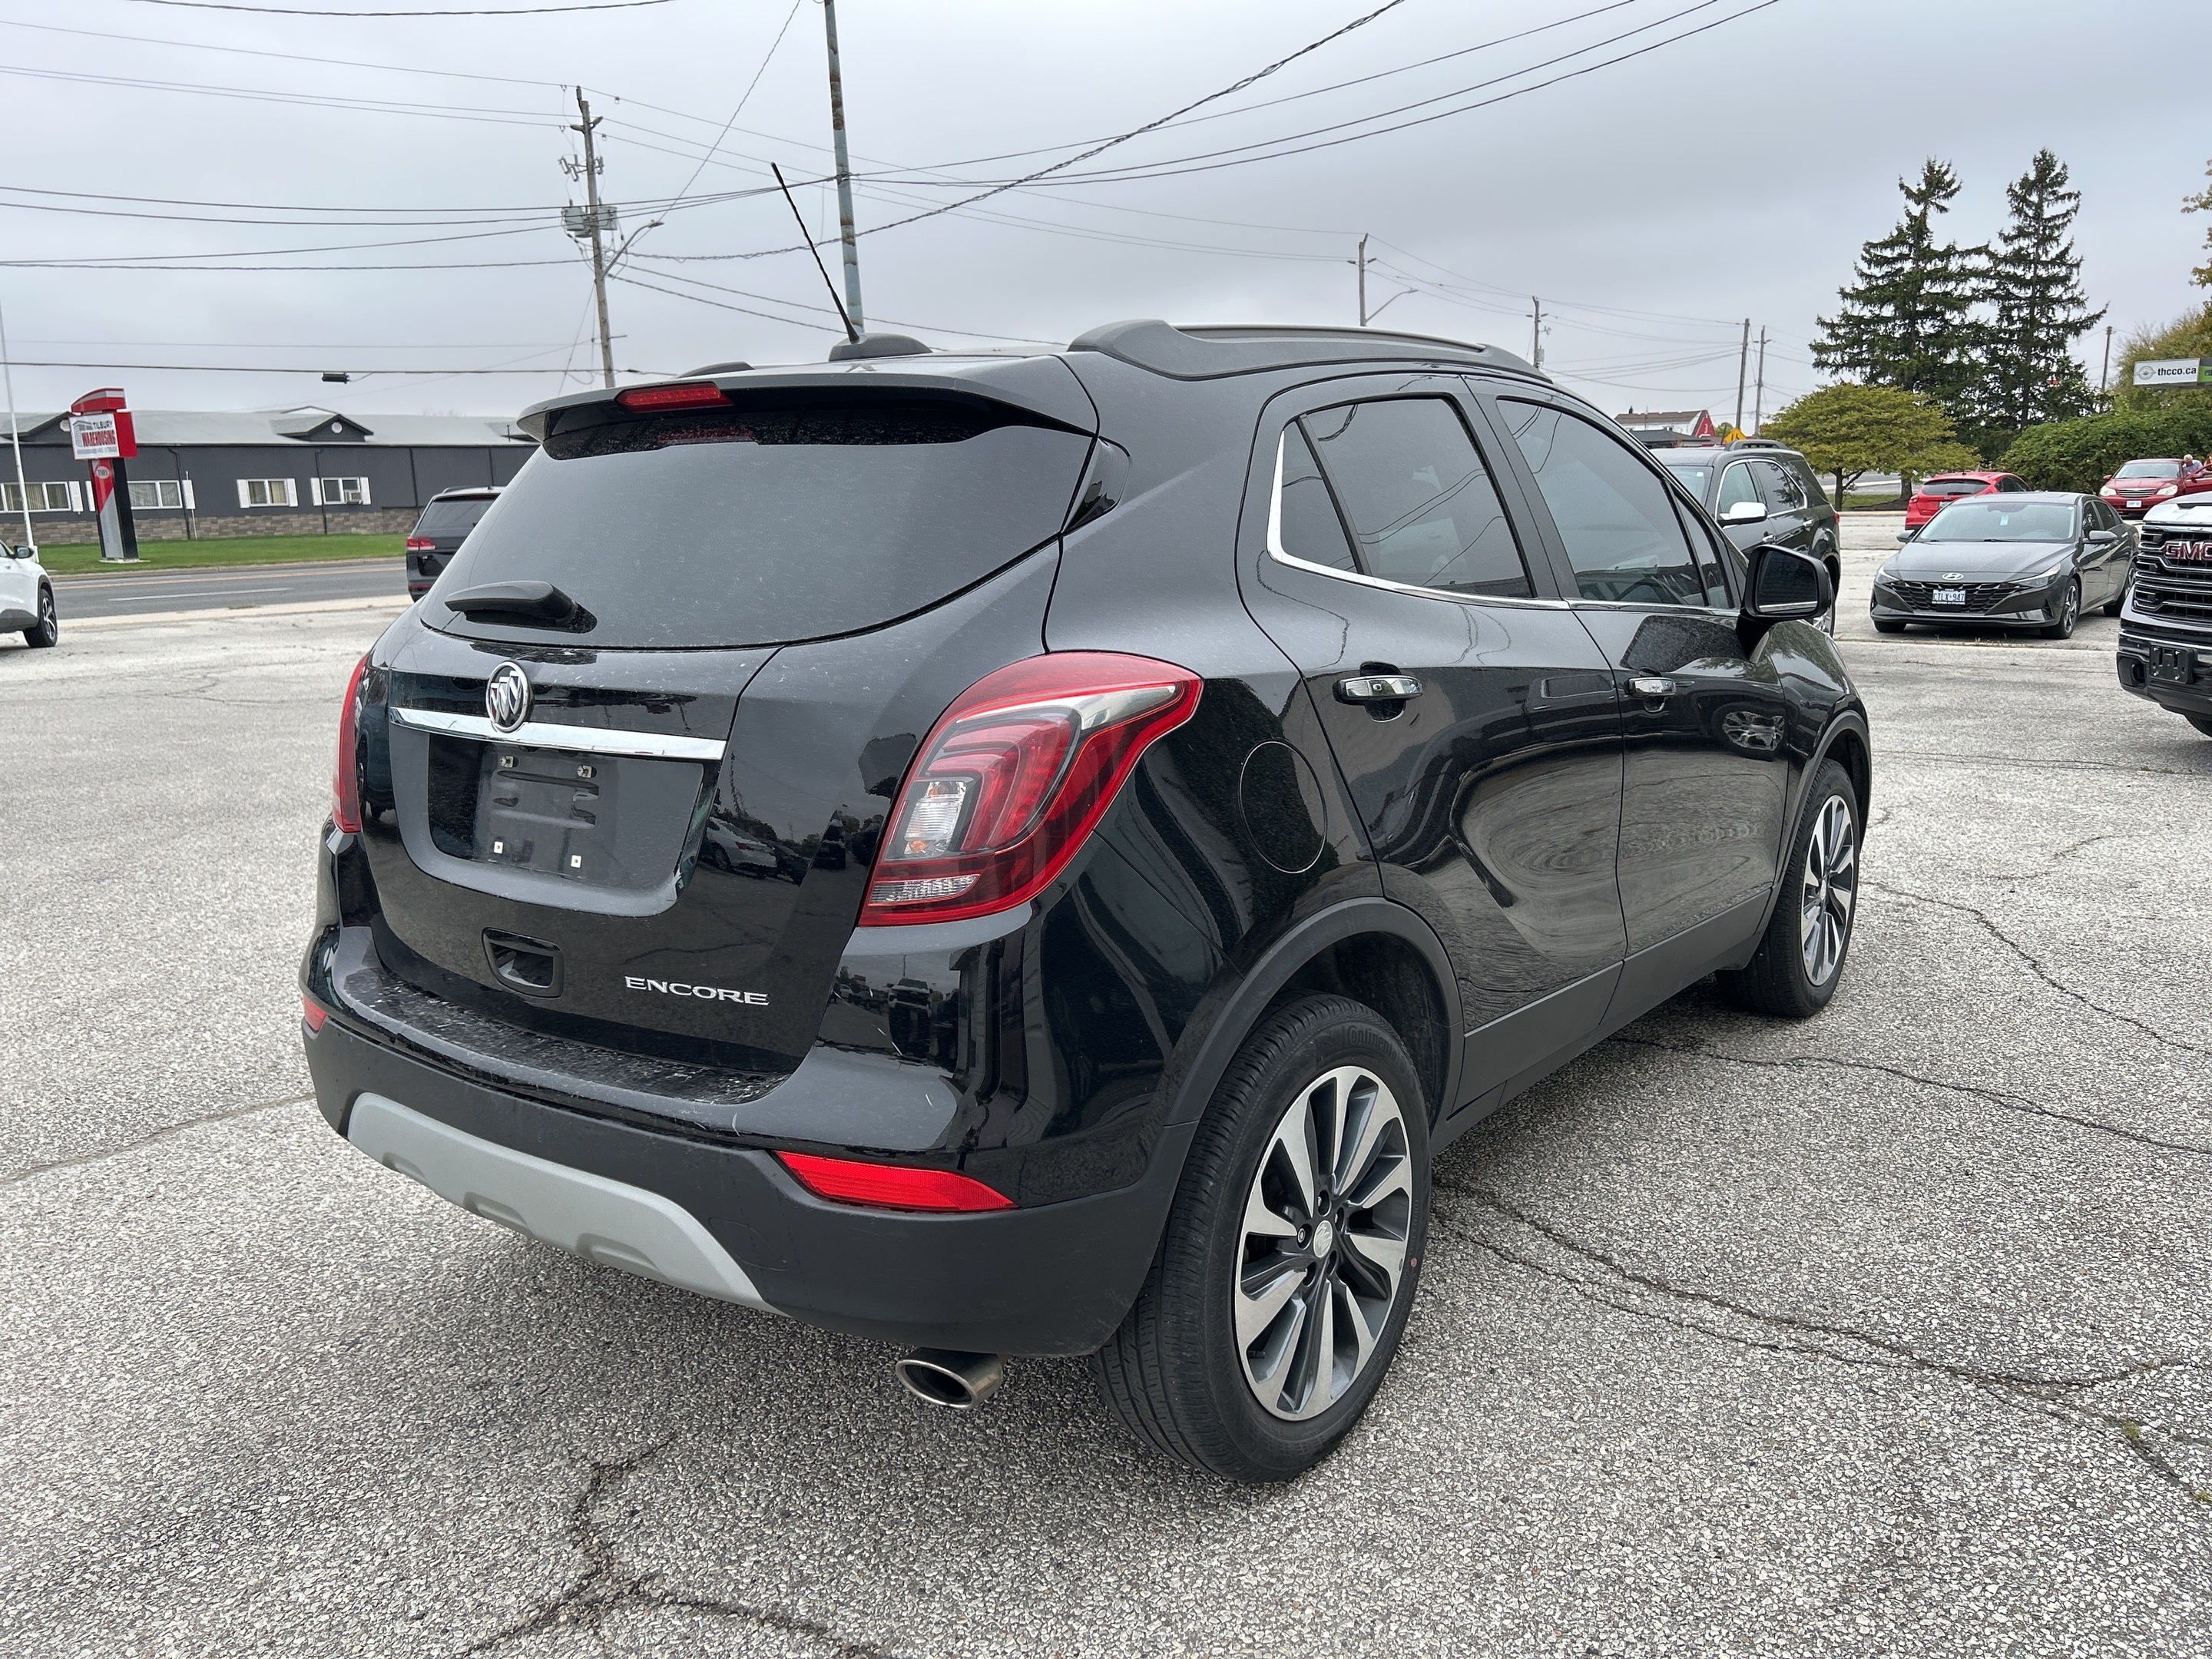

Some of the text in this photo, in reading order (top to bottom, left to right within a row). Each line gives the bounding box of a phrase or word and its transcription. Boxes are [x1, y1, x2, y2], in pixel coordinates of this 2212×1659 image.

[2157, 367, 2197, 376] thcco.ca
[93, 420, 112, 429] TILBURY
[81, 430, 116, 446] WAREHOUSING
[2163, 540, 2212, 561] GMC
[624, 975, 770, 1006] ENCORE
[1346, 1025, 1399, 1064] Continental
